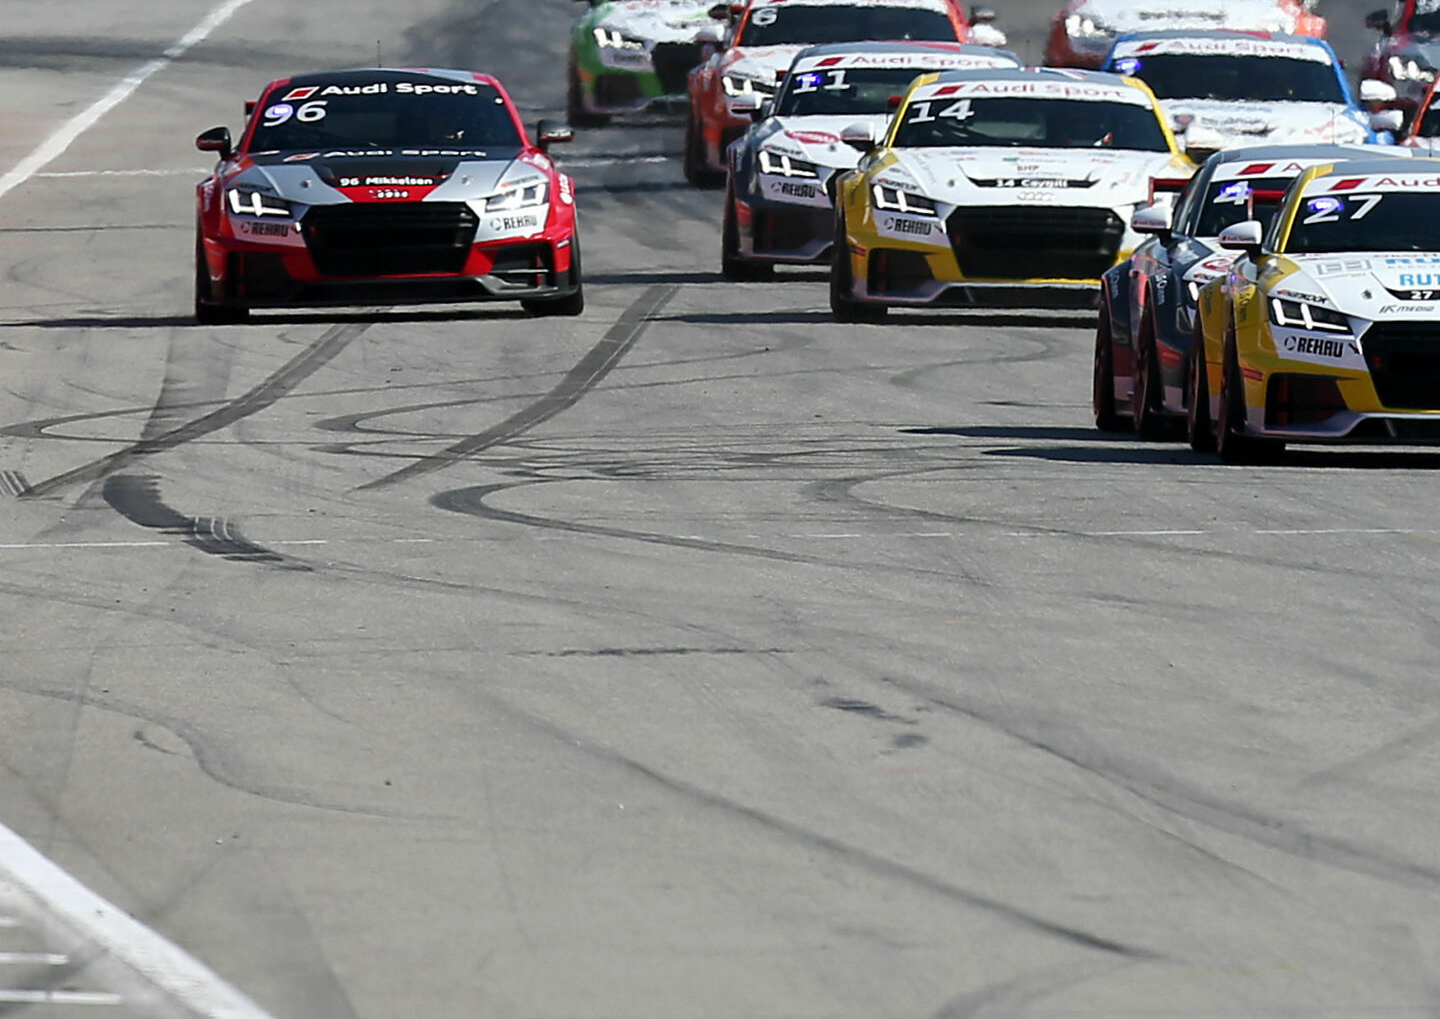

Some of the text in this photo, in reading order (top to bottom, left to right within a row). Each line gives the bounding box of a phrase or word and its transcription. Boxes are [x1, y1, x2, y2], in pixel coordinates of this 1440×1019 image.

[751, 7, 779, 26] 6
[1166, 40, 1308, 55] Audi Sport
[850, 55, 999, 68] Audi Sport
[320, 82, 478, 96] Audi Sport
[792, 69, 851, 94] 11
[969, 83, 1126, 99] Audi Sport
[263, 100, 328, 127] 96
[907, 99, 975, 124] 14
[1212, 181, 1250, 206] 4
[1302, 194, 1384, 225] 27
[1410, 290, 1434, 300] 27
[1297, 337, 1345, 358] REHAU
